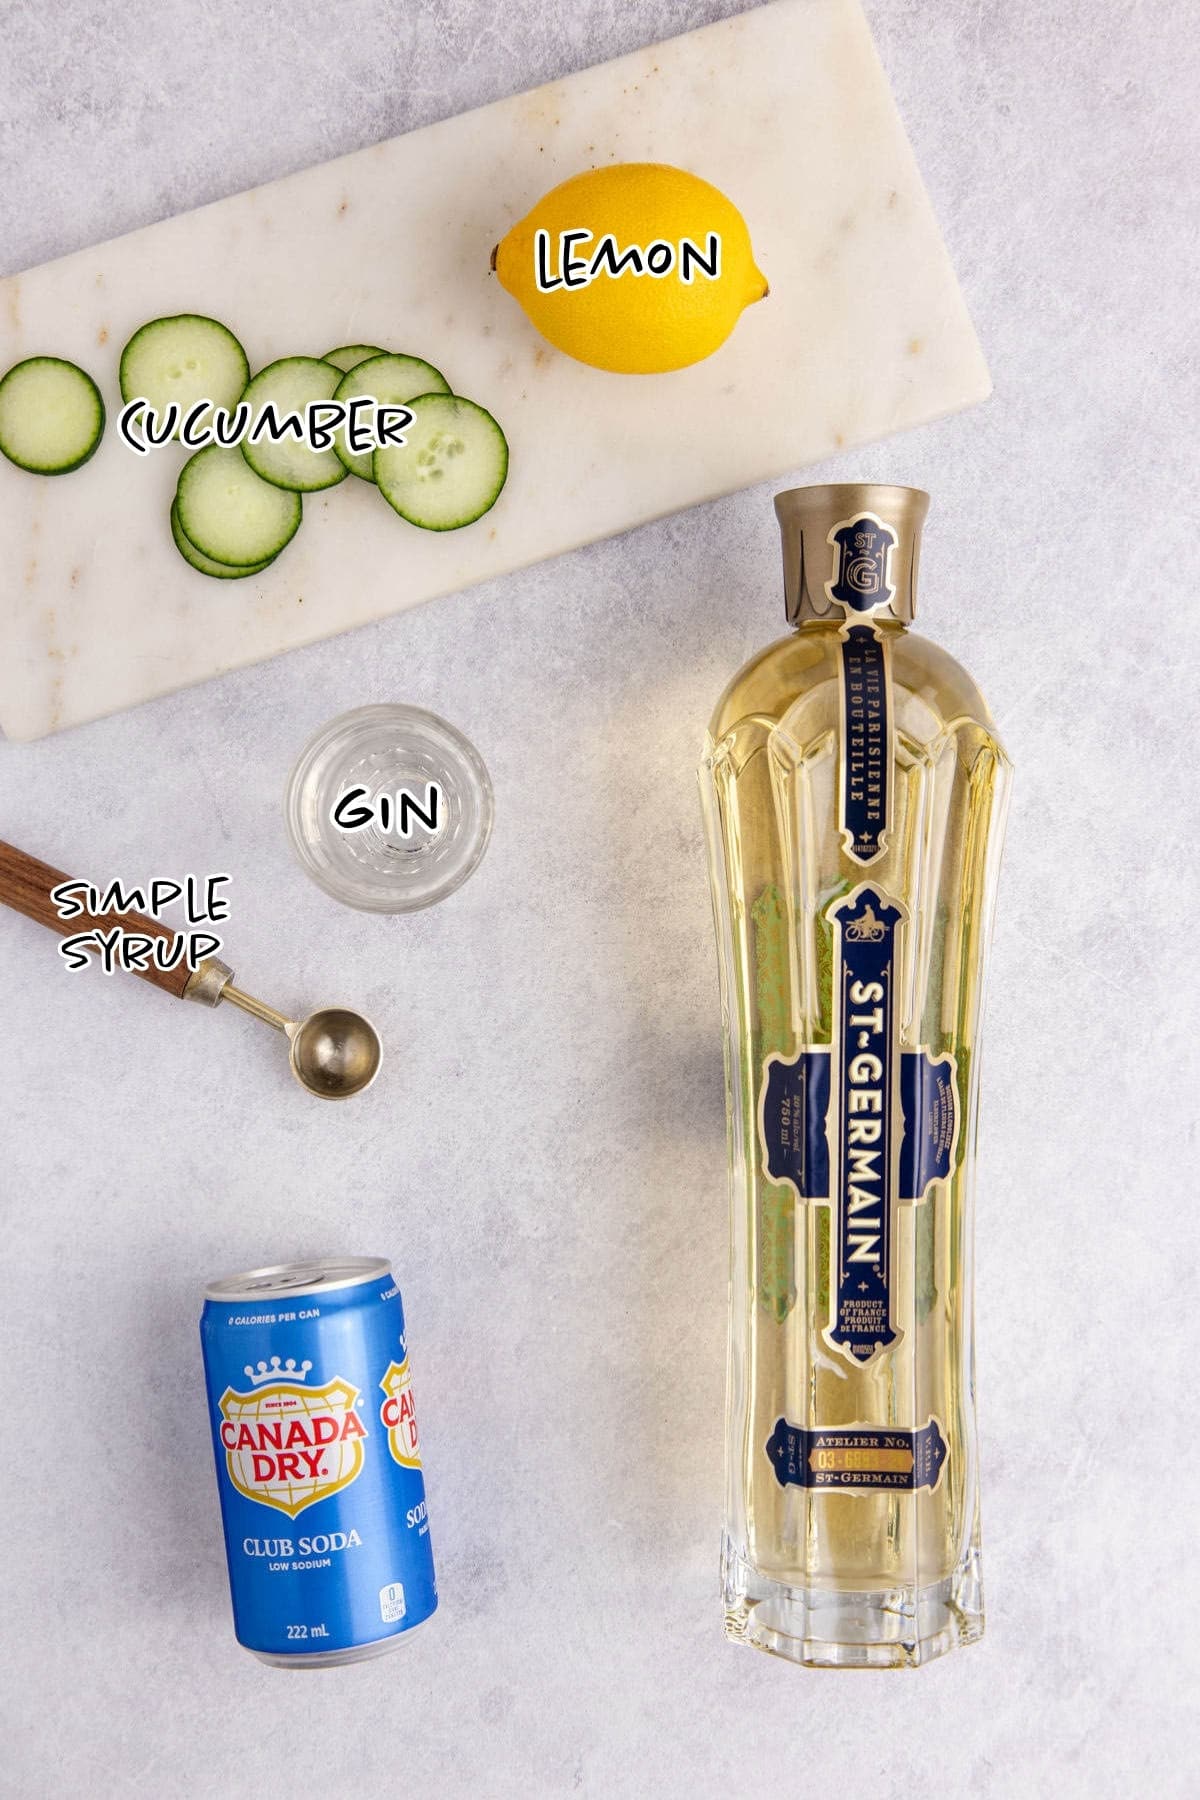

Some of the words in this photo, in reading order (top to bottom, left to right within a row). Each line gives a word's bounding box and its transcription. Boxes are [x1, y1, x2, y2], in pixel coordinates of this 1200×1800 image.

[854, 531, 877, 549] ST
[846, 556, 878, 594] G
[864, 649, 876, 663] LA
[849, 656, 862, 675] EN
[867, 669, 880, 694] VIE
[850, 682, 864, 801] BOUTEILLE
[867, 699, 881, 820] PARISIENNE
[781, 1098, 791, 1126] 750
[781, 1128, 791, 1146] ml
[840, 1308, 851, 1316] OF
[852, 1308, 887, 1317] FRANCE
[843, 1300, 883, 1308] PRODUCT
[235, 1314, 276, 1325] CALORIES
[278, 1312, 296, 1322] PER
[298, 1309, 320, 1319] CAN
[844, 1316, 882, 1325] PRODUIT
[851, 1324, 886, 1333] FRANCE
[221, 1410, 367, 1451] CANADA
[815, 1436, 879, 1447] ATELIER
[815, 1472, 909, 1484] ST-GERMAIN
[406, 1501, 426, 1528] SOD
[243, 1538, 295, 1557] CLUB
[298, 1528, 363, 1556] SODA
[269, 1562, 289, 1571] LOW
[291, 1558, 331, 1571] SODIUM
[286, 1625, 308, 1639] 222
[310, 1623, 330, 1638] mL
